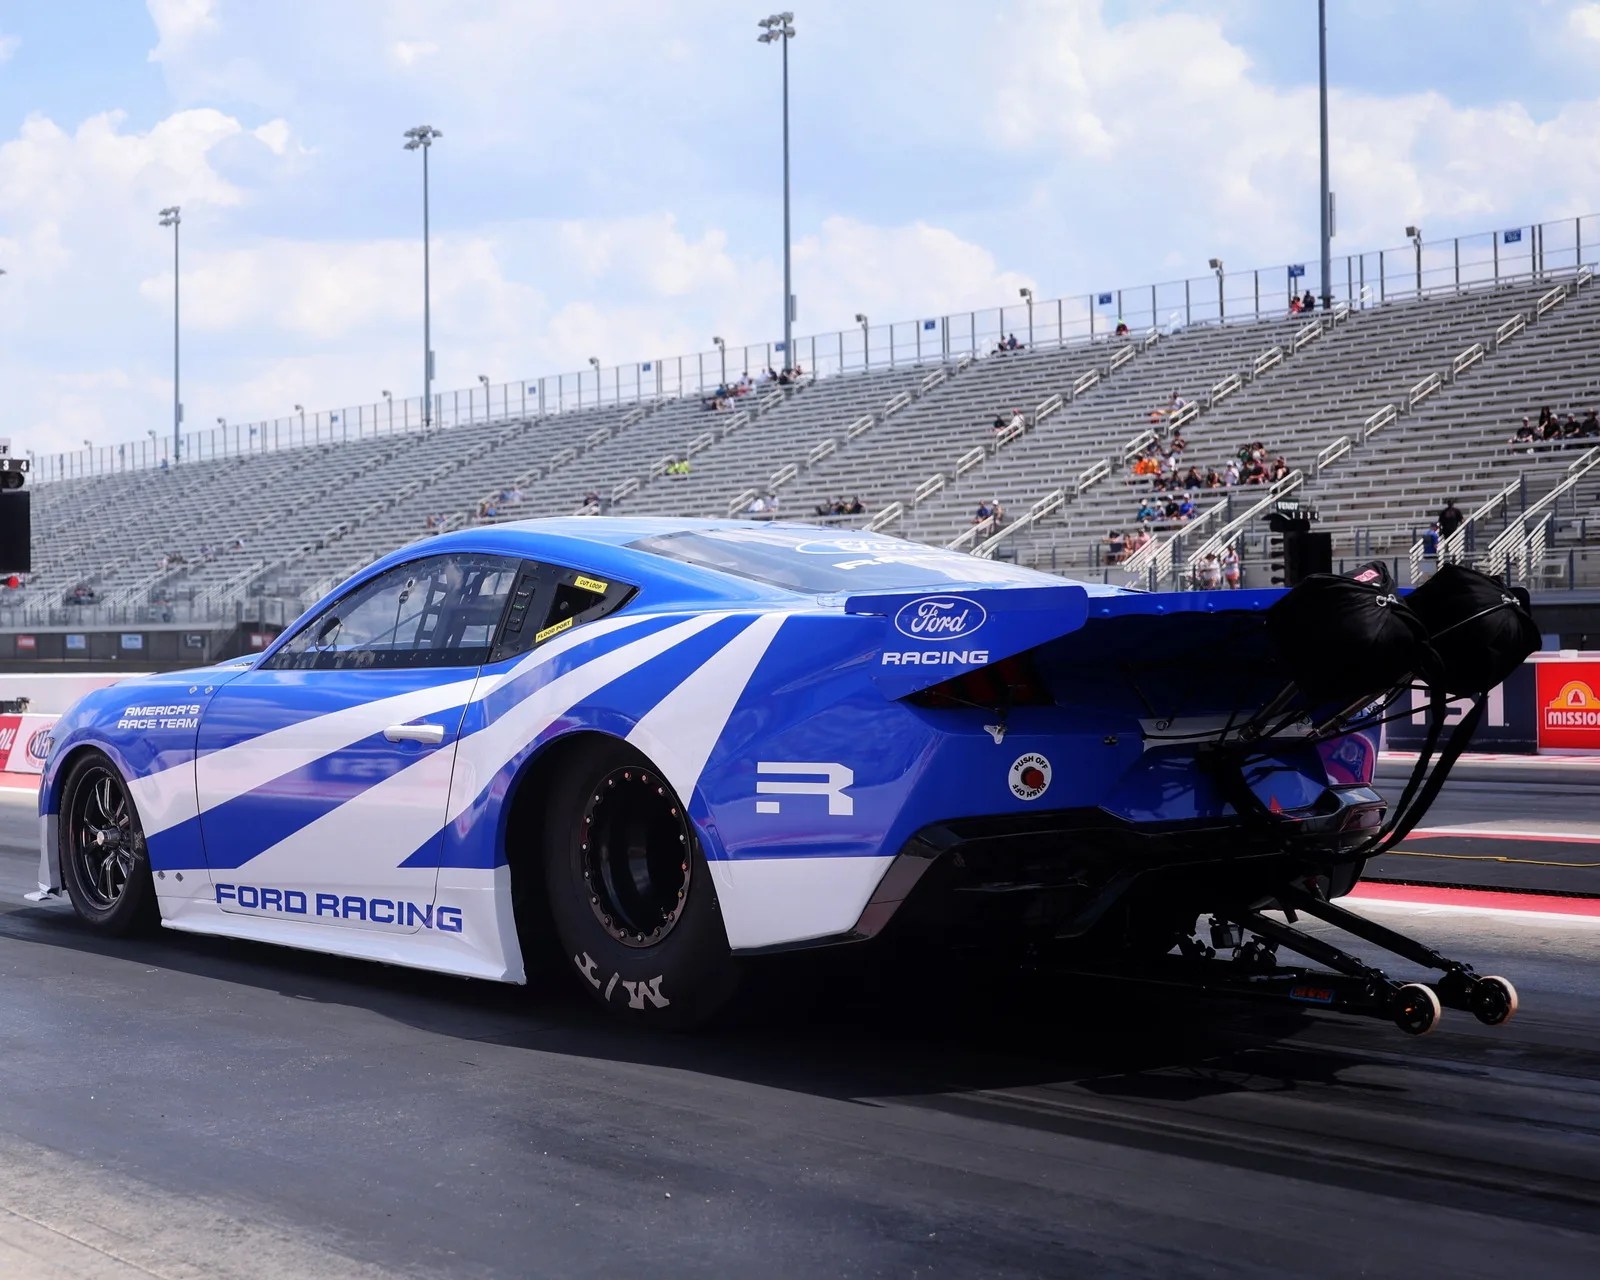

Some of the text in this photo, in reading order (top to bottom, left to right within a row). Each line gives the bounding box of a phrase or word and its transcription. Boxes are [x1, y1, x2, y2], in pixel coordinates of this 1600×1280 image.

[3, 460, 27, 471] 3 4
[911, 602, 969, 632] Ford
[537, 620, 571, 639] FLOOD PORT
[881, 651, 989, 665] RACING
[124, 705, 200, 716] AMERICA'S
[117, 718, 198, 729] RACE TEAM
[1014, 756, 1048, 771] PUSH OFF
[1012, 782, 1046, 798] PUSH OFF
[215, 883, 463, 933] FORD RACING
